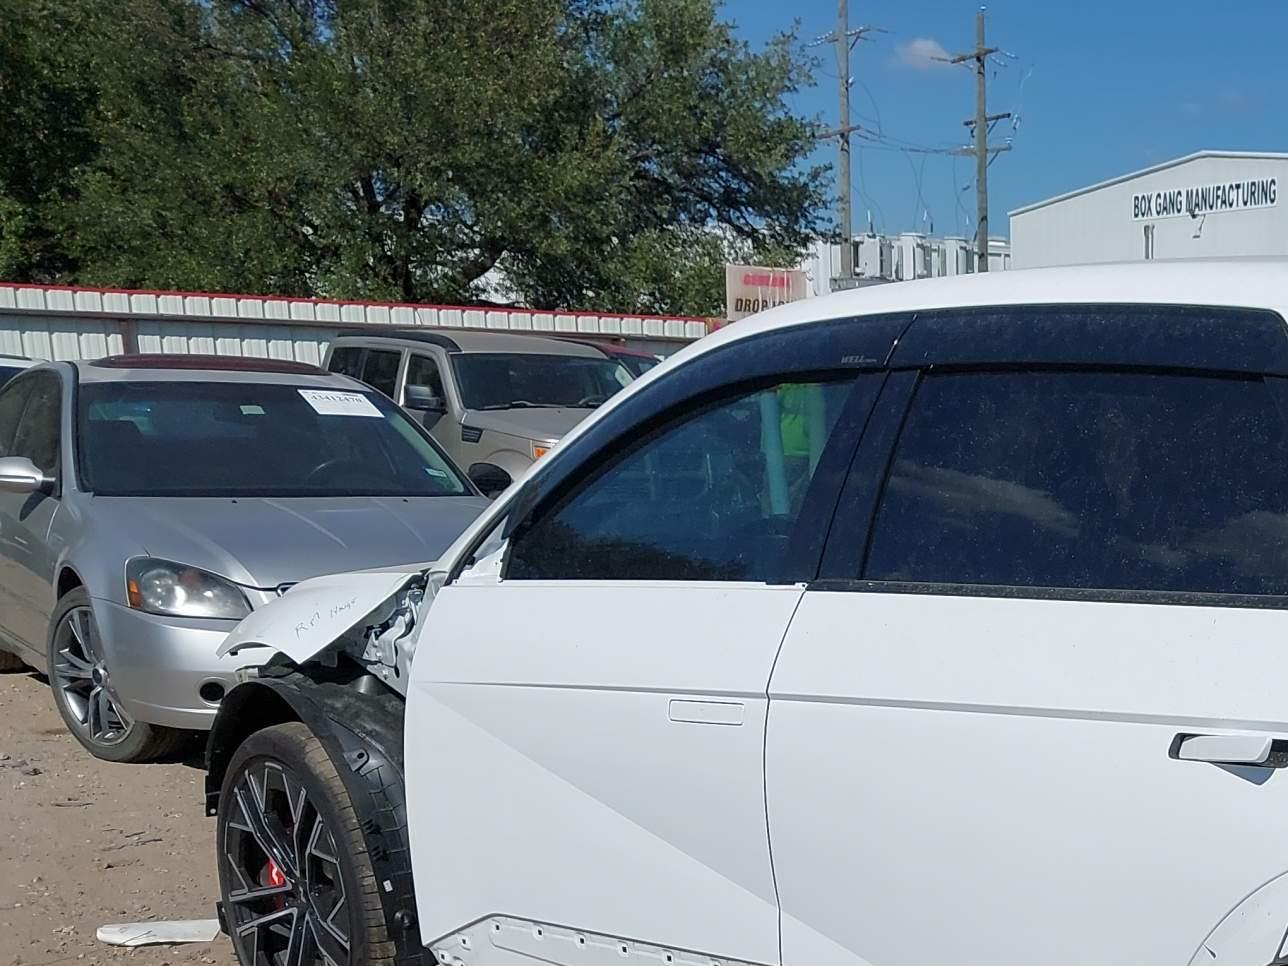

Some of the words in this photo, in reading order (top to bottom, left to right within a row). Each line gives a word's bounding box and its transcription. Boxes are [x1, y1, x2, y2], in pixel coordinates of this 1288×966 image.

[1133, 194, 1153, 218] BOX
[1155, 190, 1183, 216] GANG
[1185, 178, 1277, 213] MANUFACTURING
[735, 298, 768, 313] DROP
